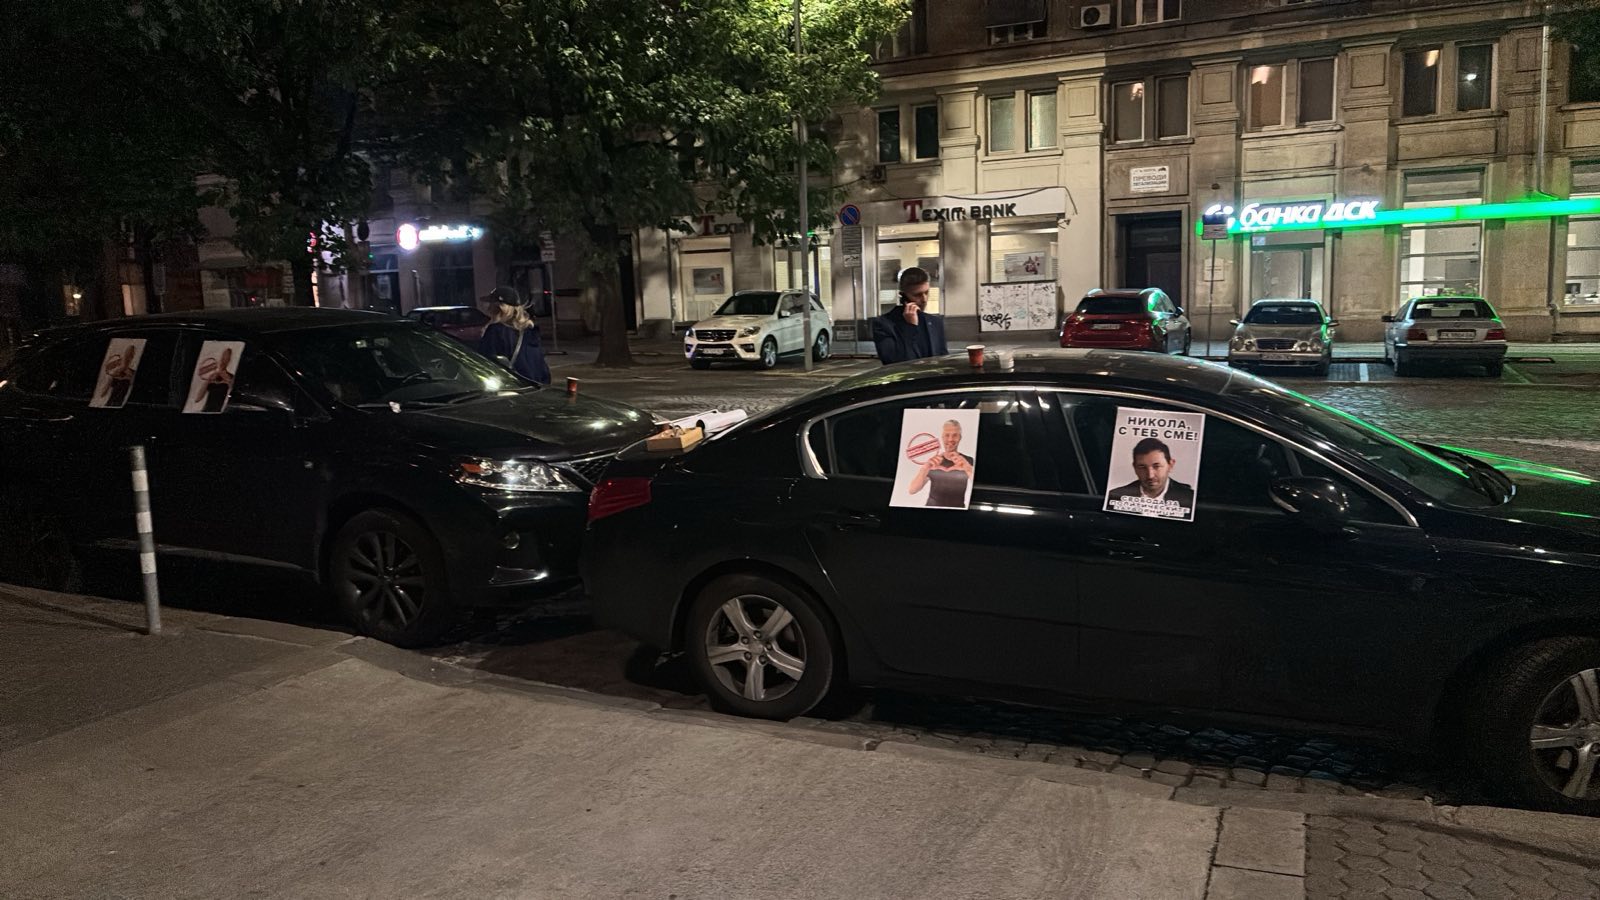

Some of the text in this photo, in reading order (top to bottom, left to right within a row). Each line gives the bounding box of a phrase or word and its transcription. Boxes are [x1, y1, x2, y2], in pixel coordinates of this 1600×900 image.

[970, 203, 1017, 219] BANK
[1240, 200, 1379, 227] банка ДСК
[1128, 416, 1191, 430] НИКОЛА,
[1118, 426, 1198, 440] С ТЕБ СМЕ!
[1121, 496, 1165, 505] СВОБОДА
